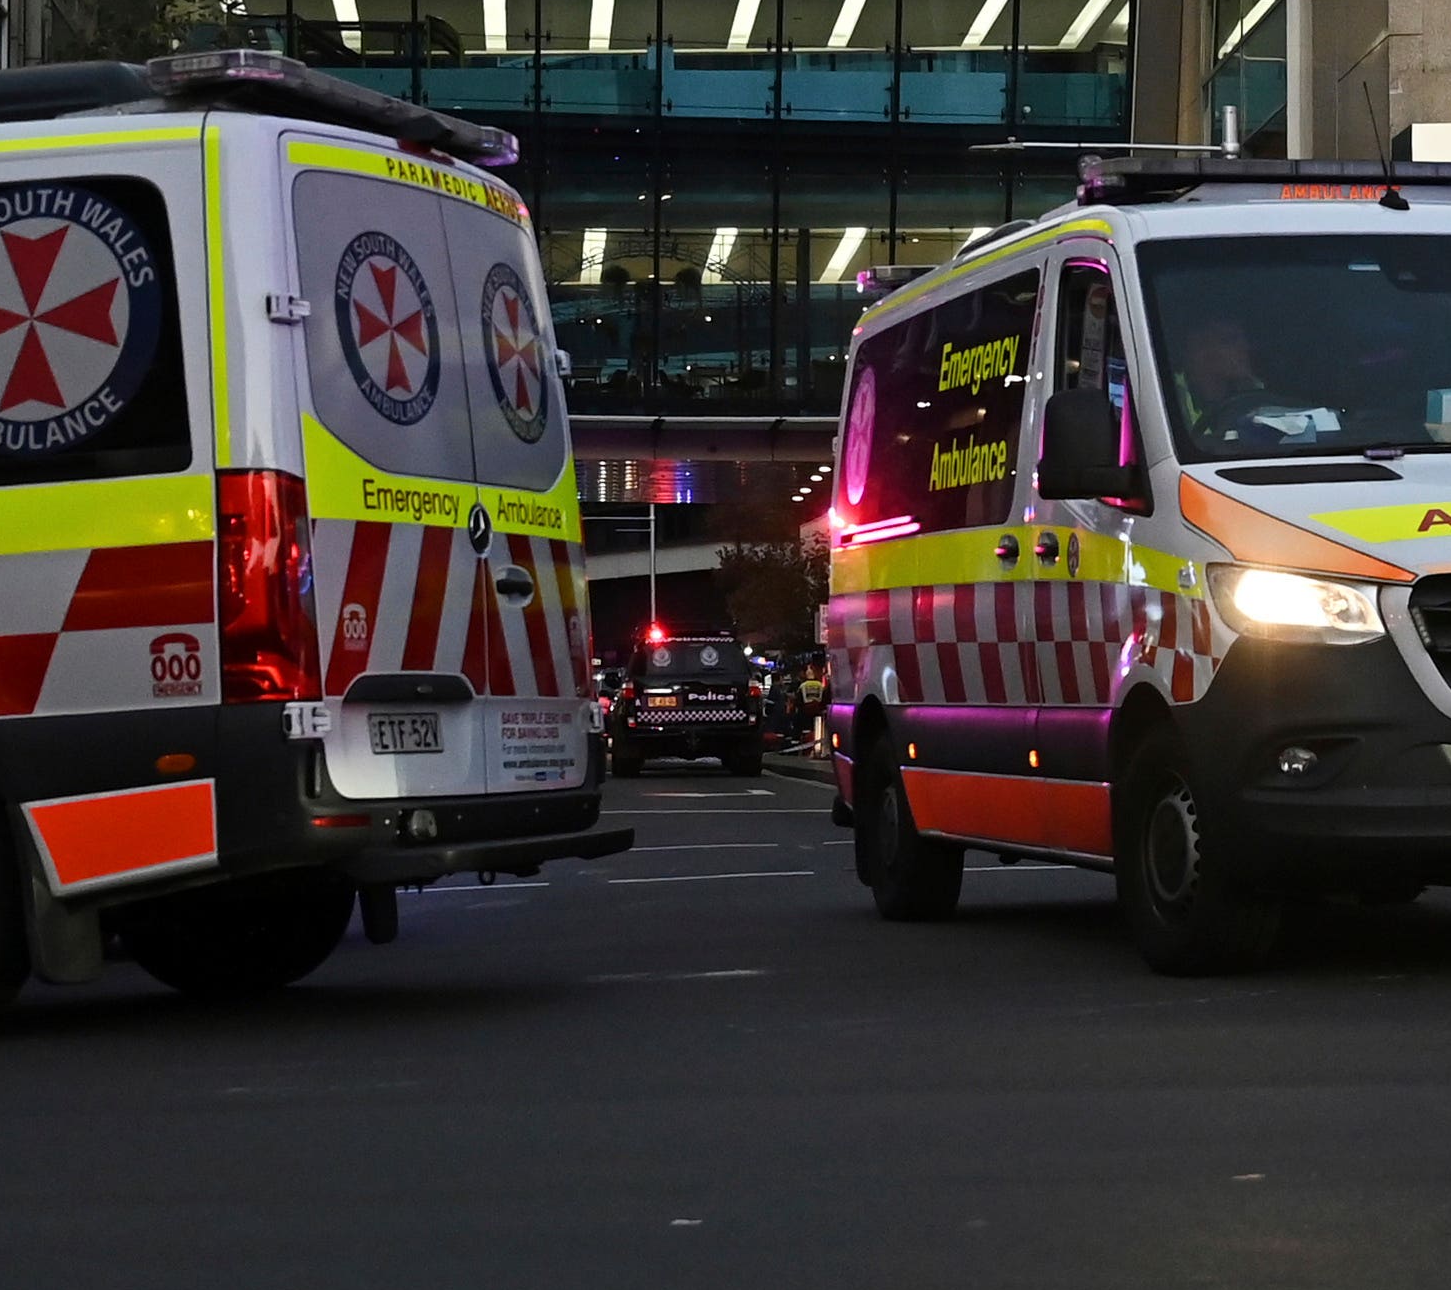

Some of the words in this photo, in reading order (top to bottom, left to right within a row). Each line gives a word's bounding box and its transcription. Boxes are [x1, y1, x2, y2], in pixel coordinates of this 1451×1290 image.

[385, 157, 479, 202] PARAMEDIC
[1280, 183, 1402, 200] AMBULANC
[79, 197, 156, 288] WALES
[336, 251, 358, 300] NEW
[353, 234, 396, 259] SOUTH
[938, 334, 1020, 396] Emergency
[928, 434, 1008, 493] Ambulance
[362, 478, 460, 525] Emergency
[497, 493, 562, 530] Ambulance
[343, 620, 368, 640] 000
[151, 653, 201, 682] 000
[688, 690, 735, 701] Police
